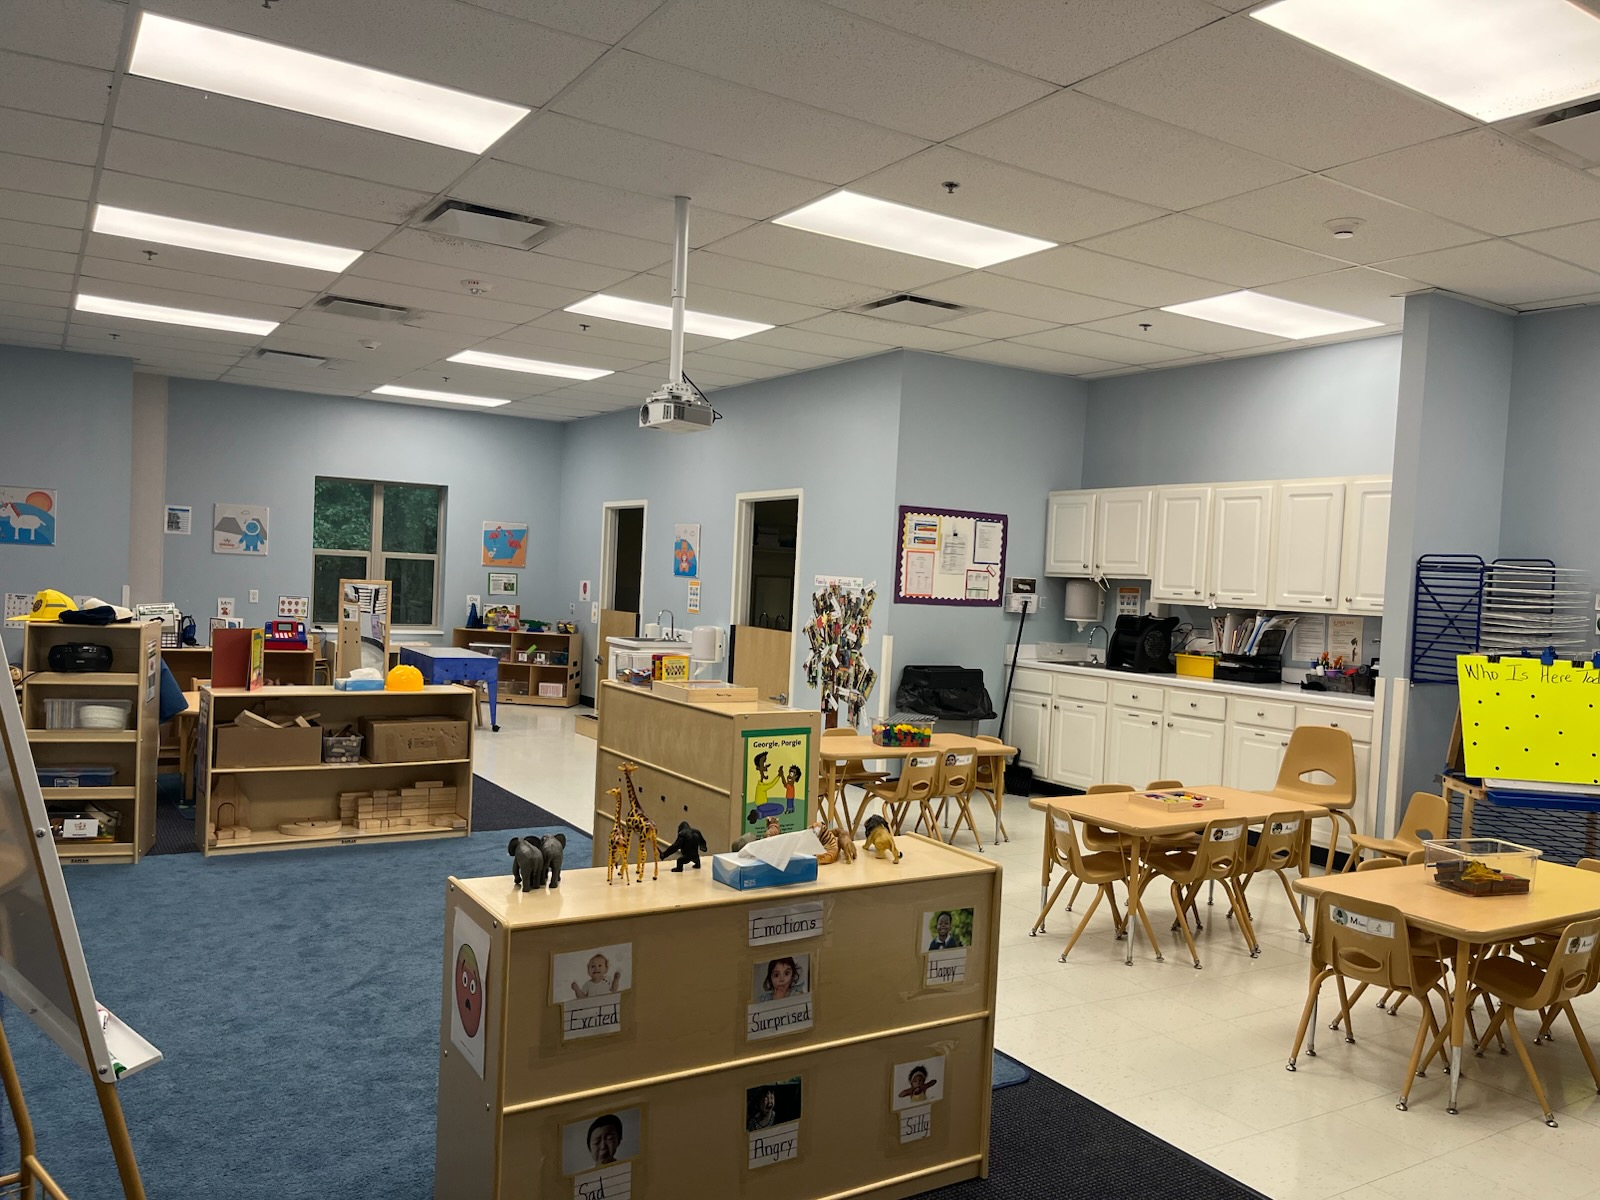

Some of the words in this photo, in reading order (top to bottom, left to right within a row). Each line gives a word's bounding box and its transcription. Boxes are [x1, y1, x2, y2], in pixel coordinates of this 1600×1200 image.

[1464, 664, 1499, 681] Who
[1505, 664, 1529, 682] Is
[1540, 666, 1573, 684] Here
[753, 741, 780, 749] Georgie,
[781, 739, 802, 747] Porgie
[752, 915, 816, 939] Emotions
[929, 960, 957, 983] Happy
[570, 1003, 619, 1031] Excited
[751, 1002, 810, 1033] Surprised
[905, 1114, 929, 1139] Silly
[754, 1138, 794, 1162] Angry
[578, 1175, 606, 1200] Sad
